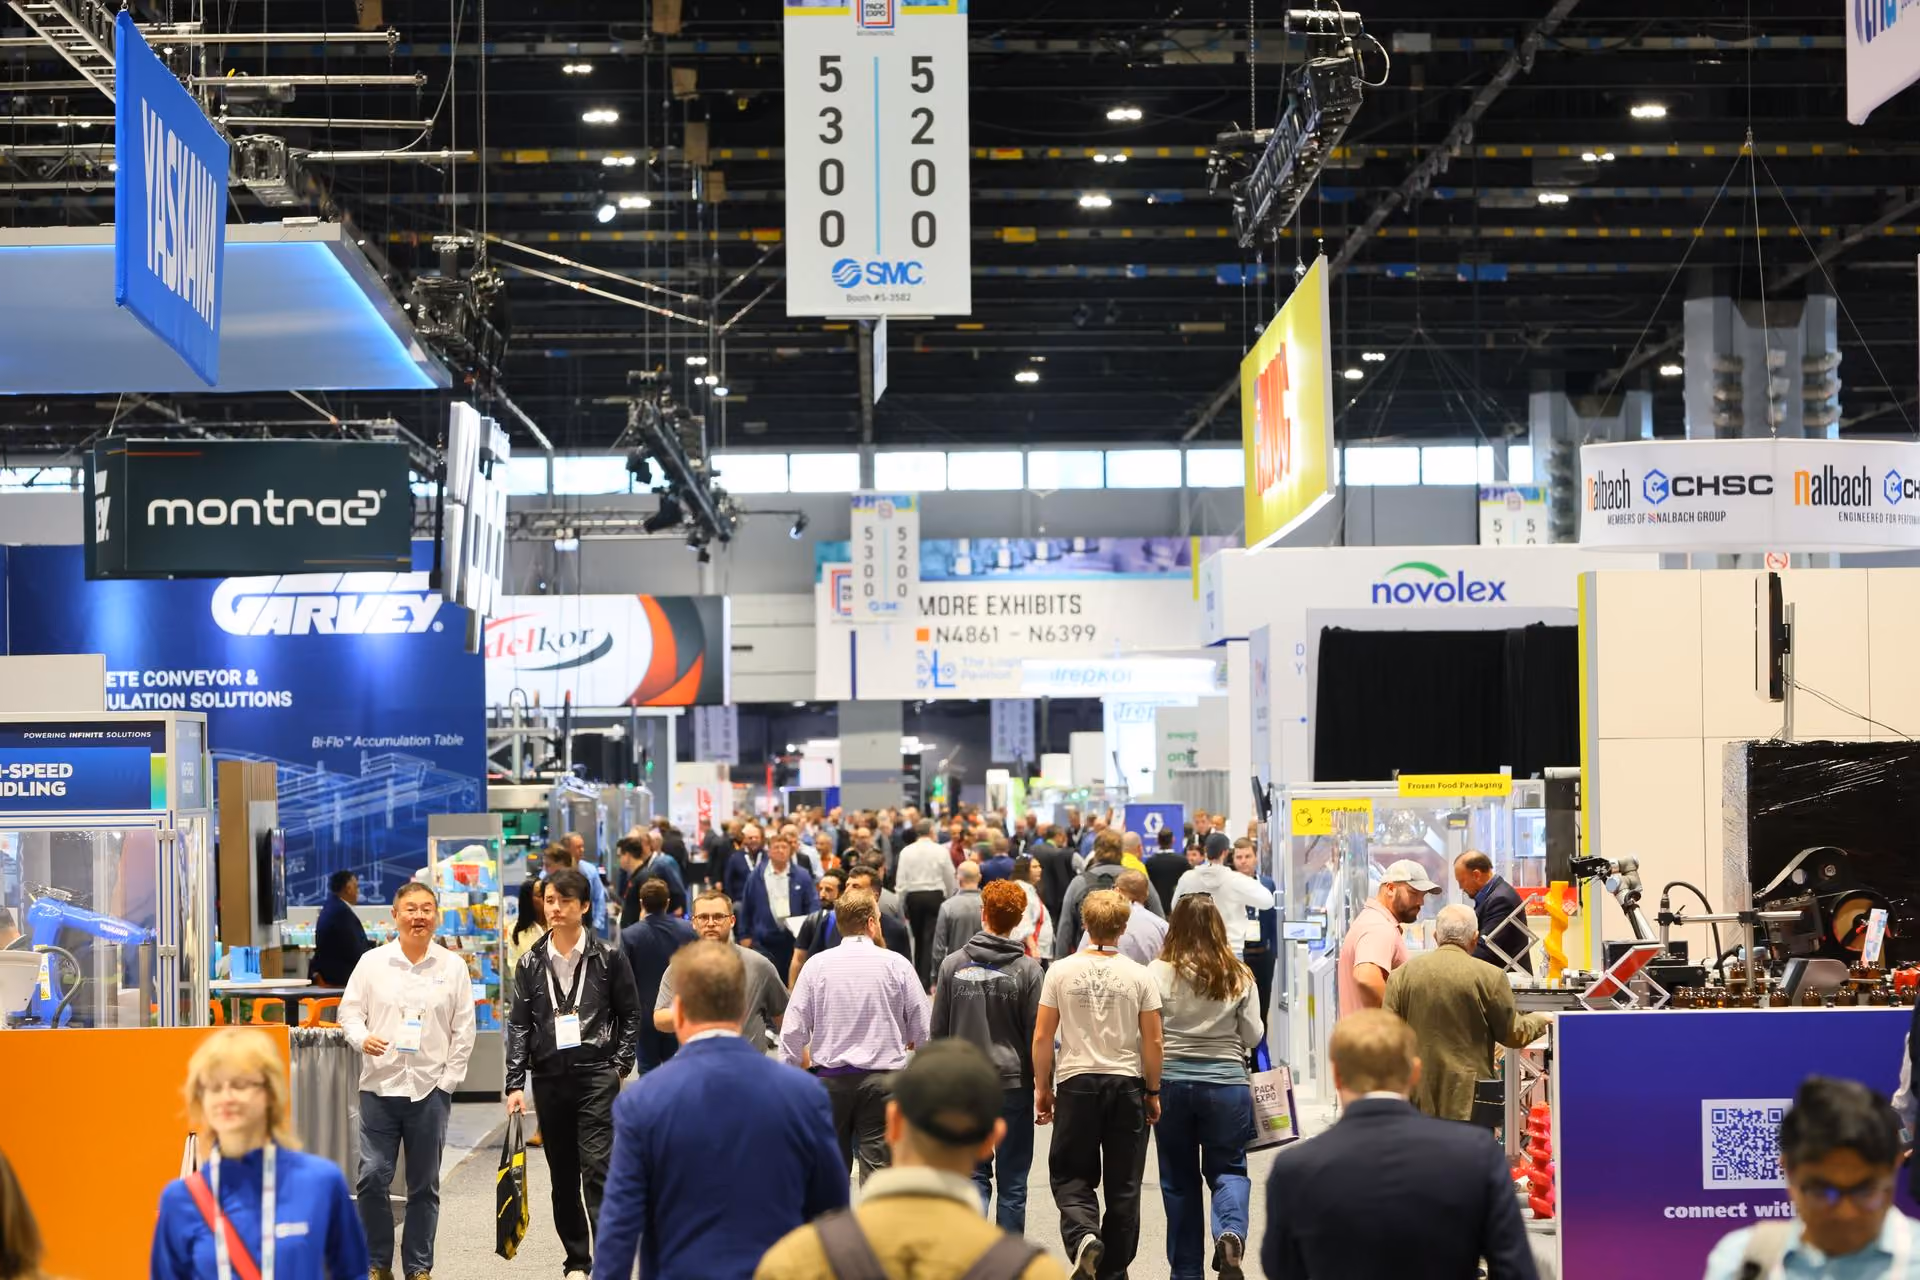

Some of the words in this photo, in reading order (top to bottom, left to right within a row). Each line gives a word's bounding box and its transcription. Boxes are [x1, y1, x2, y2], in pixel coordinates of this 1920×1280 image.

[141, 96, 217, 331] YASKAWA
[865, 261, 923, 285] SMC
[1671, 474, 1774, 497] CHSC
[1607, 512, 1636, 525] MEMBERS
[1637, 512, 1646, 524] OF
[1656, 511, 1695, 524] NALBACH
[1696, 511, 1727, 523] GROUP
[1838, 511, 1884, 524] ENGINEERED
[1371, 570, 1507, 605] novolex
[918, 595, 978, 616] MORE
[986, 594, 1082, 616] EXHIBITS
[936, 625, 999, 643] N4861
[1028, 624, 1096, 643] N6399
[485, 626, 594, 659] delkor
[143, 669, 242, 687] CONVEYOR
[245, 669, 259, 686] &
[105, 692, 186, 710] ULATION
[189, 690, 293, 708] SOLUTIONS
[23, 732, 67, 740] POWERING
[106, 731, 152, 739] SOLUTIONS
[353, 734, 432, 748] Accumulation
[433, 733, 465, 747] Table
[0, 762, 74, 779] -SPEED
[0, 781, 67, 797] DLING
[1459, 781, 1503, 790] Packaging
[1254, 1083, 1277, 1095] PACK
[1255, 1092, 1277, 1104] EXPO
[1664, 1202, 1748, 1219] connect
